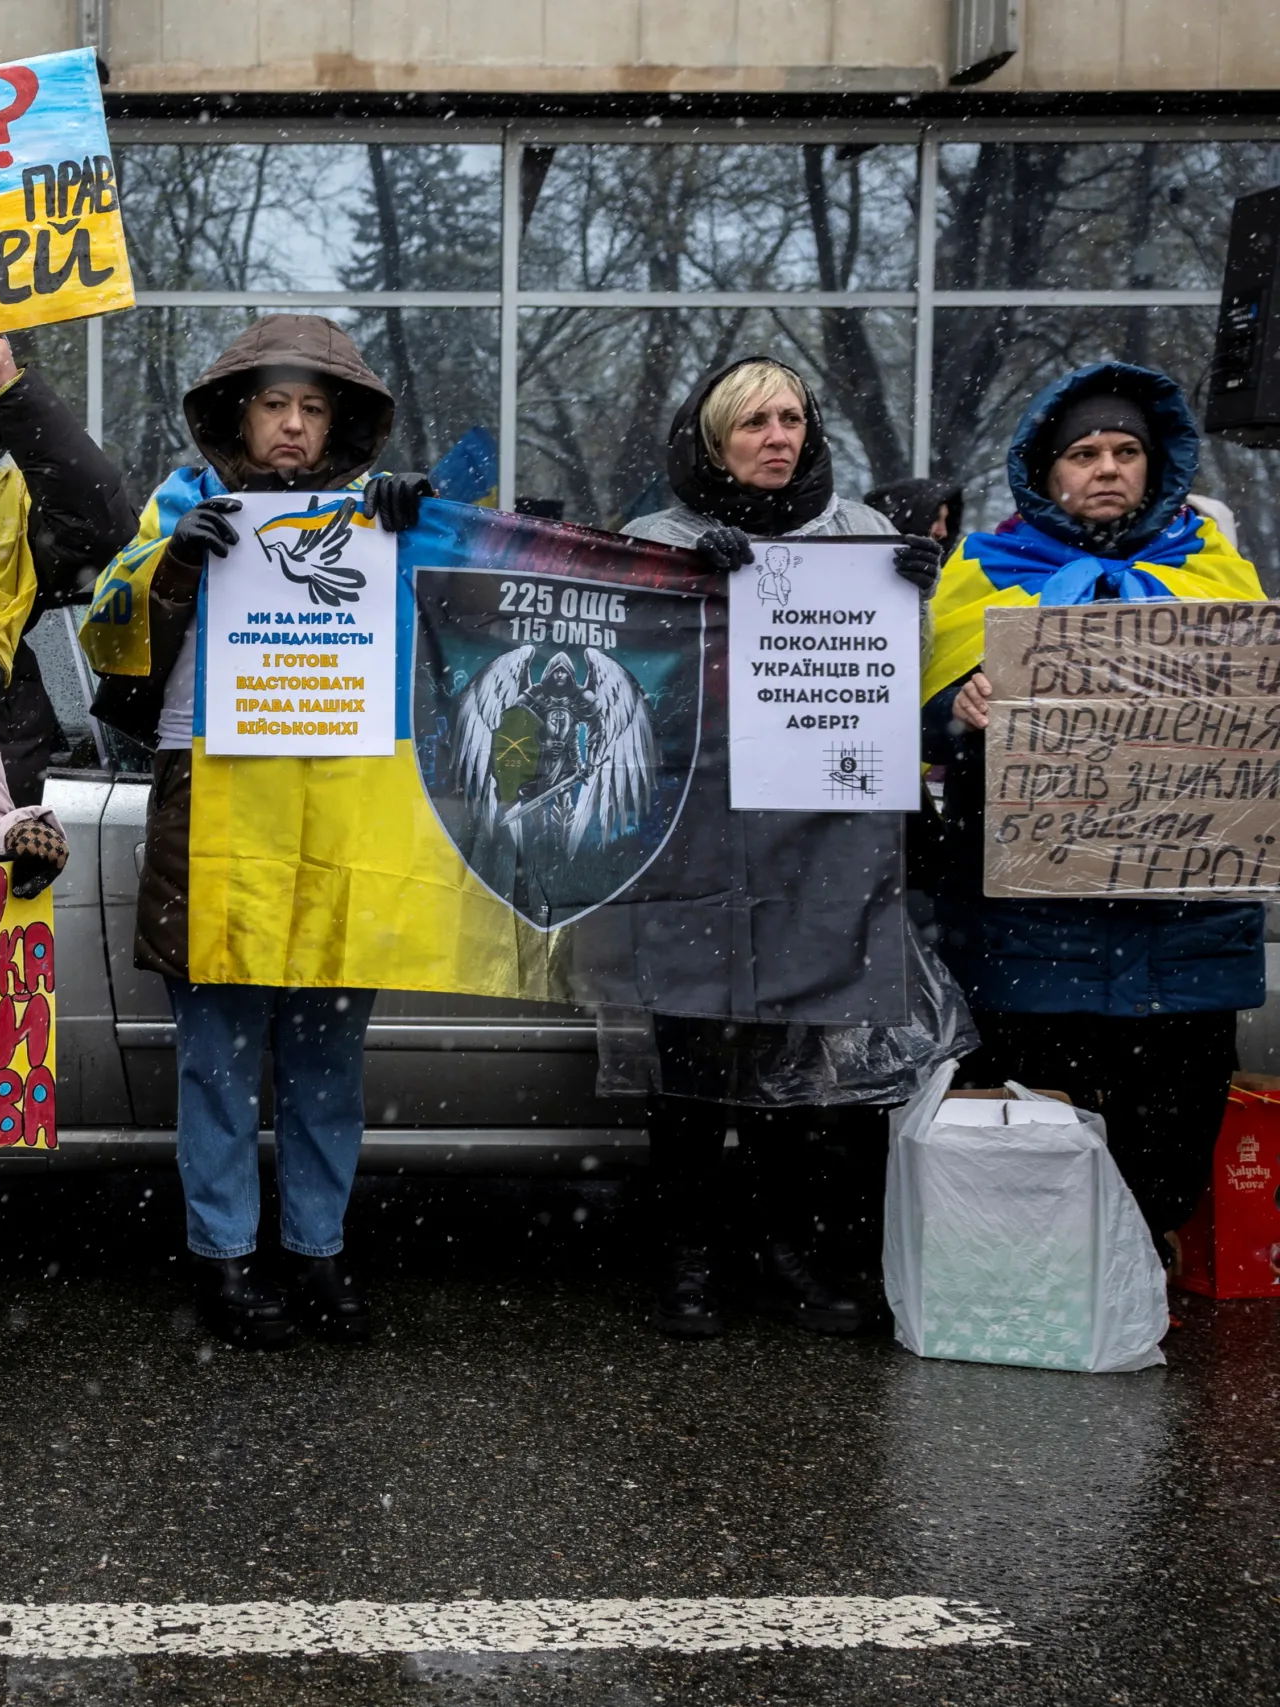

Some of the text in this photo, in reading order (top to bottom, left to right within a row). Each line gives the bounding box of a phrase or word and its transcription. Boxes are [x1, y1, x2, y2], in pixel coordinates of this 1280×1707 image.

[22, 155, 120, 222] ПРАВ
[498, 581, 627, 623] 225 ОШБ
[247, 612, 356, 624] МИ ЗА МИР ТА
[772, 610, 877, 624] КОЖНОМУ
[228, 632, 374, 645] СПРАВЕДЛИВІСТЬ!
[509, 617, 617, 650] 115 ОМБр
[759, 636, 888, 651] ПОКОЛІННЮ
[263, 654, 338, 667] І ГОТОВІ
[751, 659, 896, 678] УКРАЇНЦІВ ПО
[236, 676, 365, 690] ВІДСТОЮВАТИ
[757, 685, 890, 703] ФІНАНСОВІЙ
[236, 699, 365, 712] ПРАВА НАШИХ
[237, 718, 358, 735] ВІЙСЬКОВИХ!
[786, 715, 860, 729] АФЕРІ?
